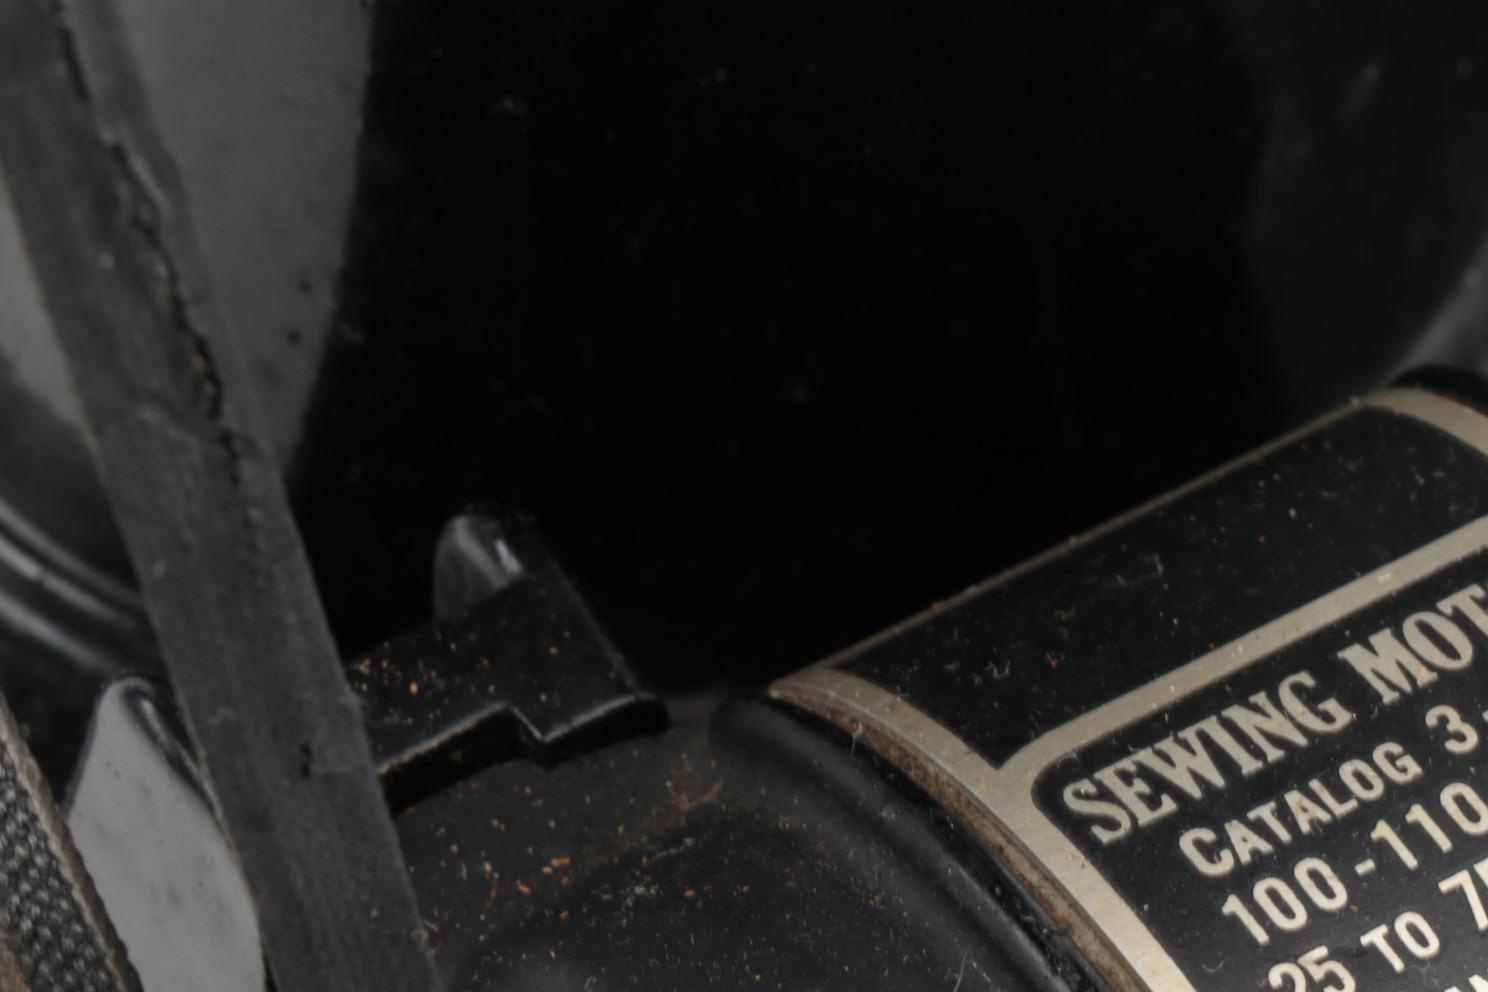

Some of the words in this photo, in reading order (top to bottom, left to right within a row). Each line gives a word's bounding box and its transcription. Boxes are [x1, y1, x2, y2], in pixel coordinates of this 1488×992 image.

[1064, 672, 1356, 844] SEWING
[1179, 742, 1423, 877] CATALOG
[1359, 911, 1441, 973] TO
